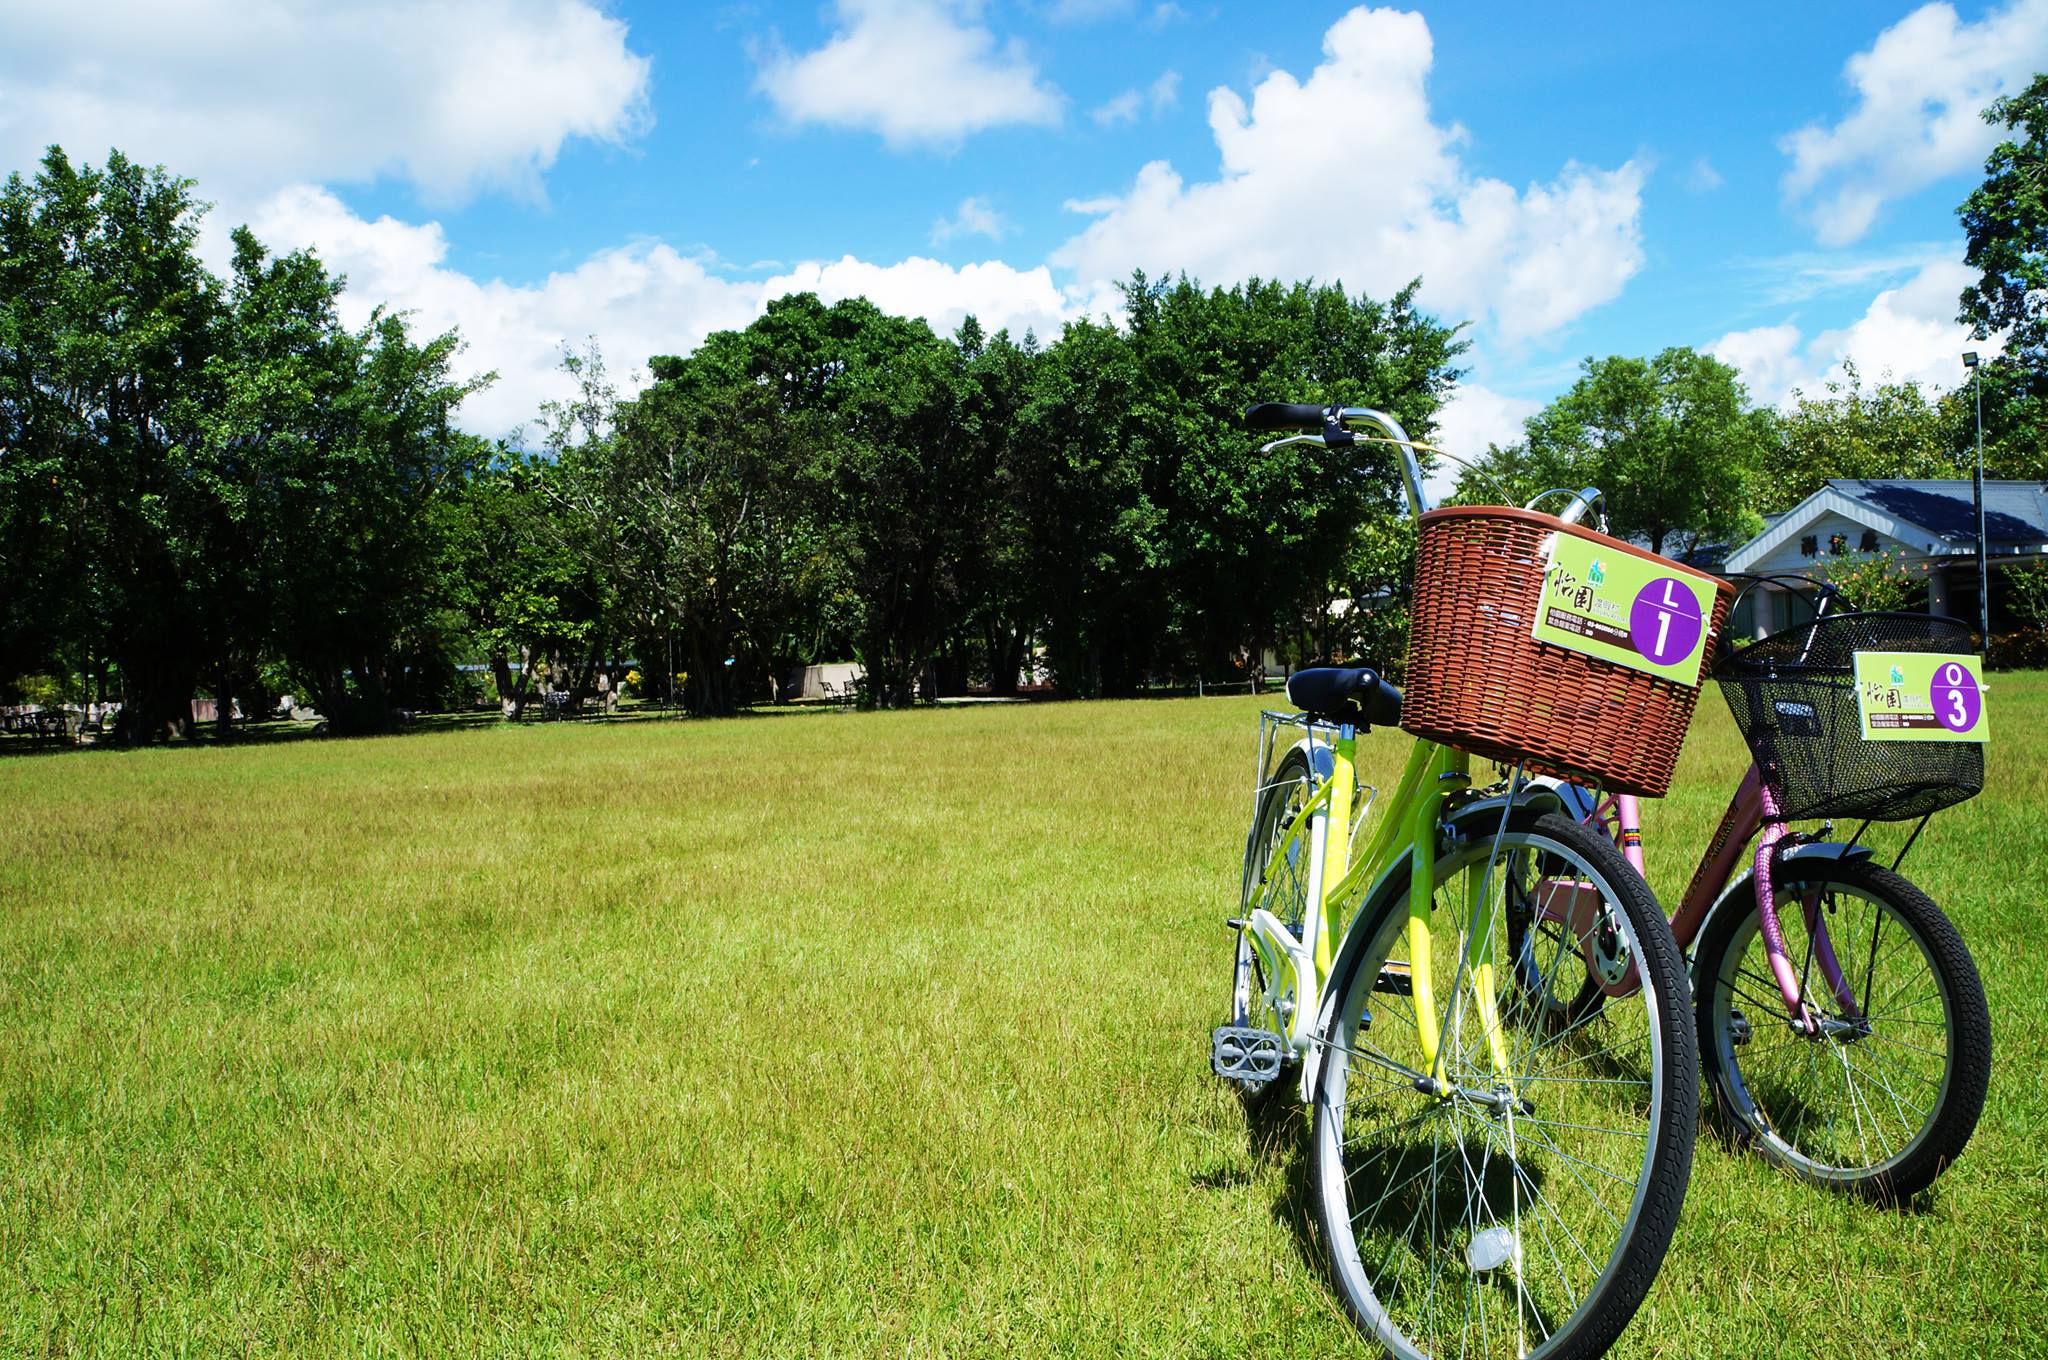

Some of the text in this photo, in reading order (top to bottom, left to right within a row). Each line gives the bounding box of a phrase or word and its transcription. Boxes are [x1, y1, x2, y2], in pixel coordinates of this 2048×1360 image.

[1663, 580, 1679, 608] L
[1654, 611, 1672, 657] 1
[1947, 689, 1967, 727] 3
